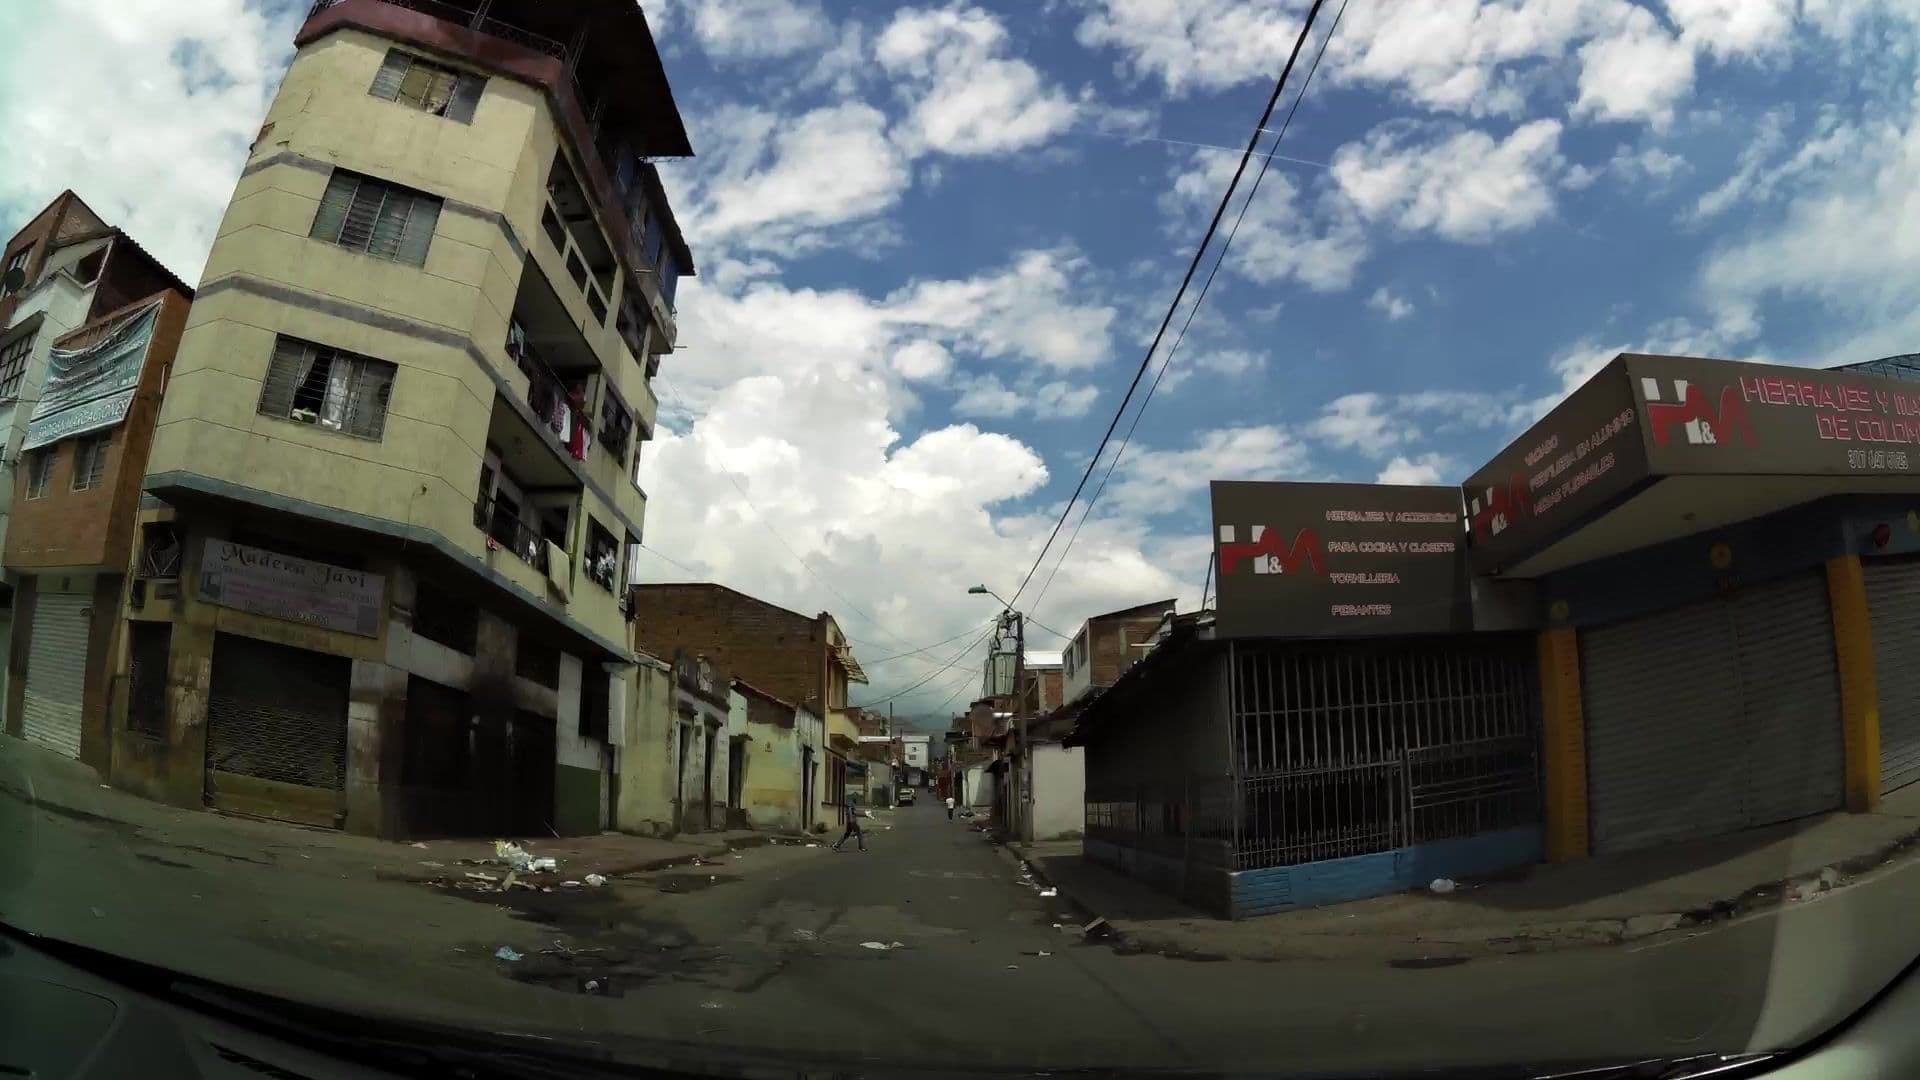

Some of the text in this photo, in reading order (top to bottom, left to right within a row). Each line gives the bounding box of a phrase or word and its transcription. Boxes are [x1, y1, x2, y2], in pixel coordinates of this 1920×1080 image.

[1739, 376, 1873, 412] HERRAJES
[1874, 389, 1889, 413] Y
[1816, 412, 1852, 441] DE
[1328, 542, 1359, 553] PARA
[1358, 542, 1399, 553] COCINA
